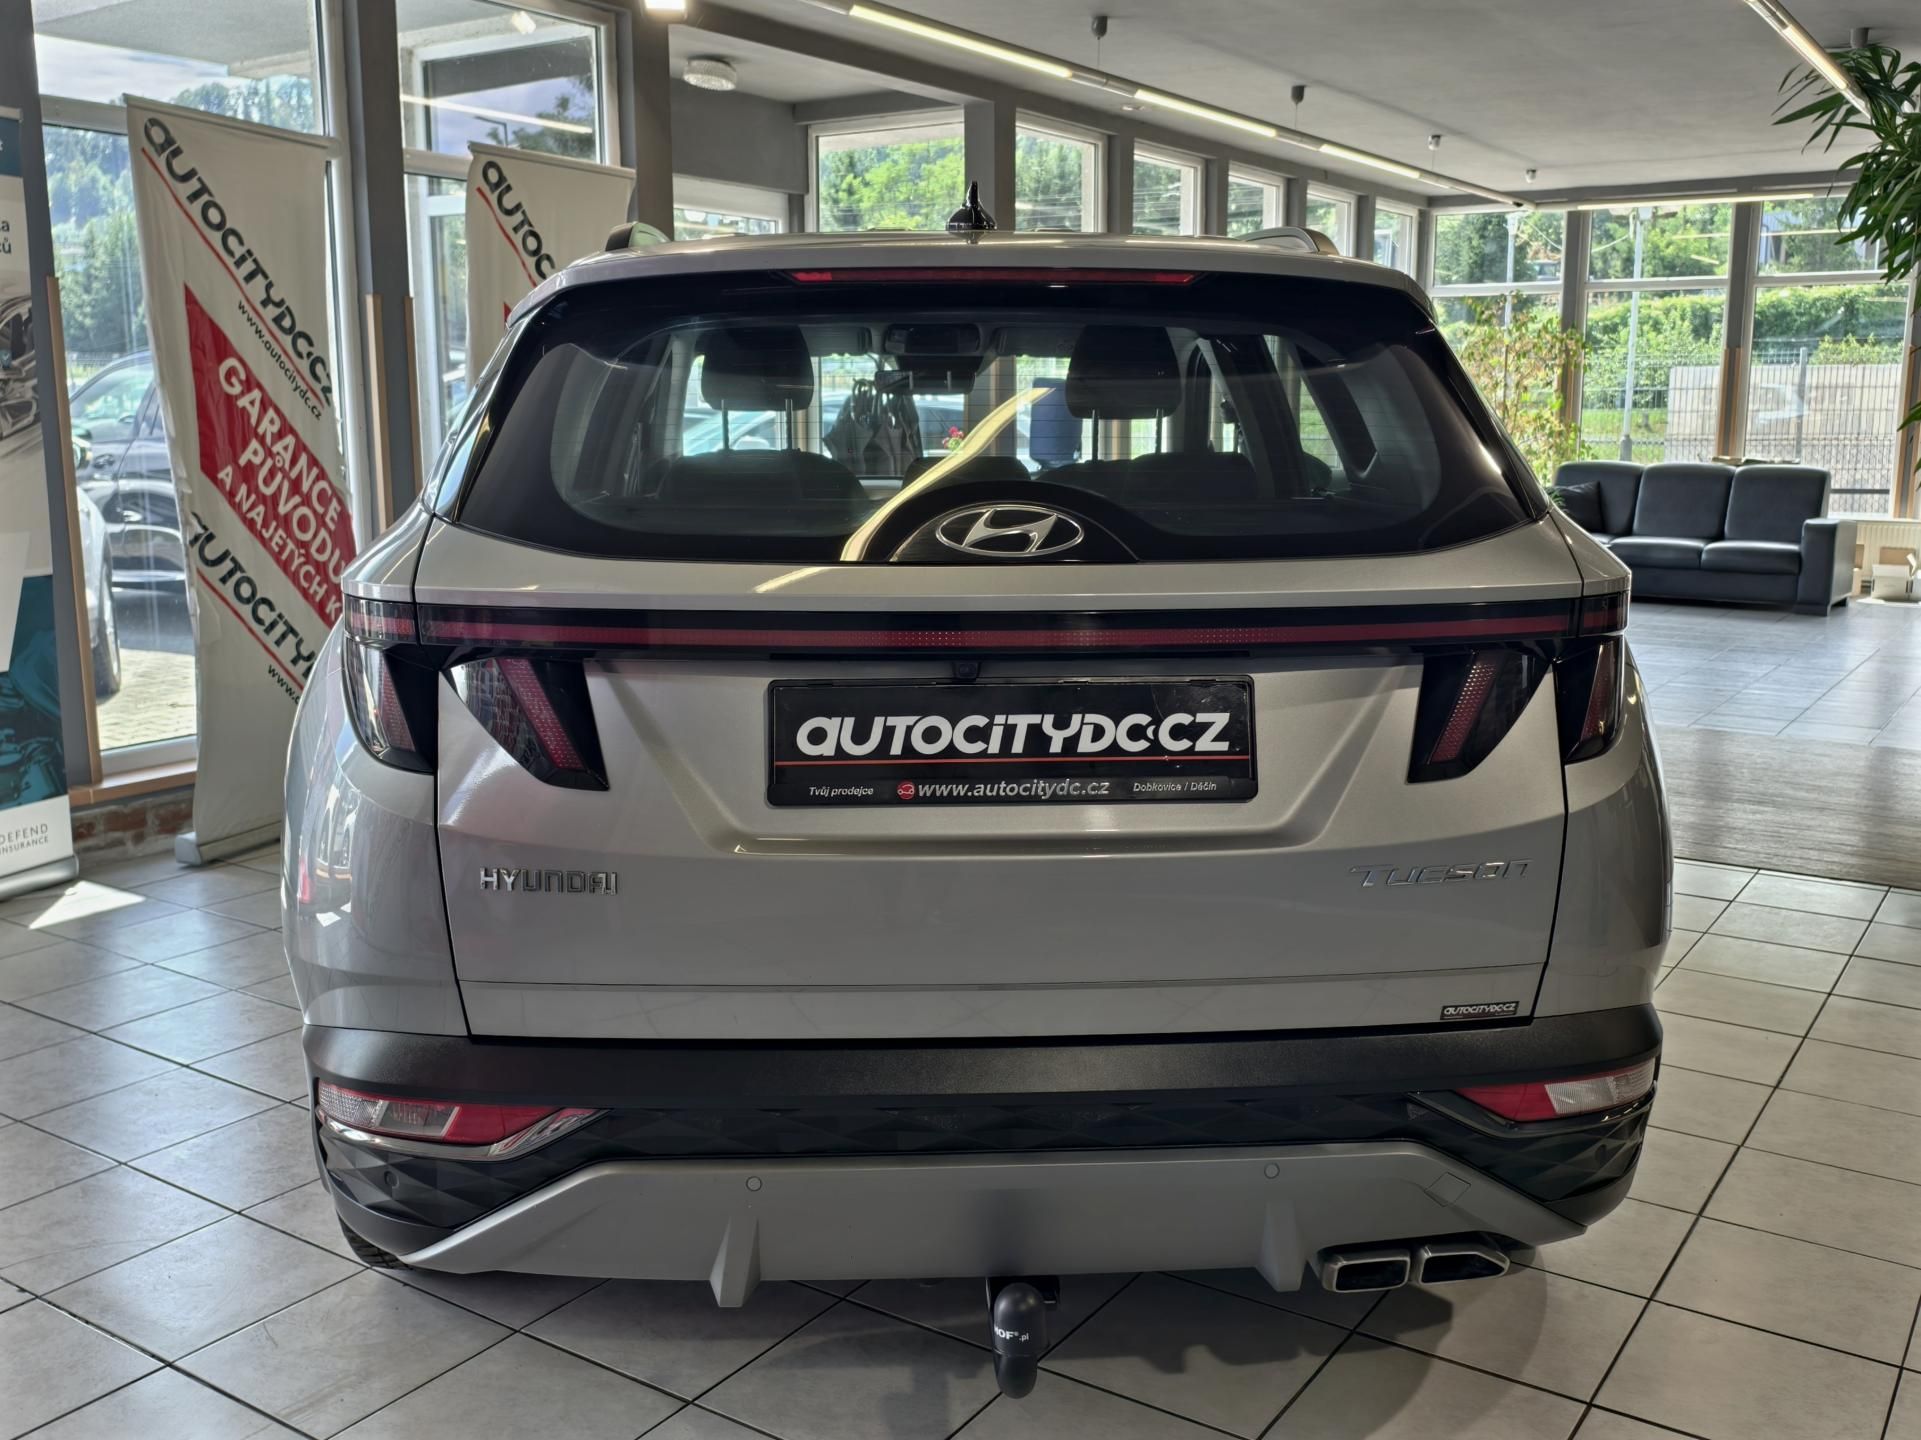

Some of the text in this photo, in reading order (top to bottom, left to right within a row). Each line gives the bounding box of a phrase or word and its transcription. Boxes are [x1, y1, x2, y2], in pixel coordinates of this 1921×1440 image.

[482, 160, 556, 280] AUTOC
[238, 300, 322, 421] www.autocitydc.cz
[218, 357, 341, 531] GARANCE
[217, 464, 343, 621] A NAJETÝCH K
[238, 438, 345, 584] PŮVODU
[809, 786, 874, 798] Tvůj prodejce
[918, 778, 1110, 799] www.autocitydc.cz
[480, 867, 618, 896] HYUNDAI
[1350, 857, 1534, 888] TUCSON
